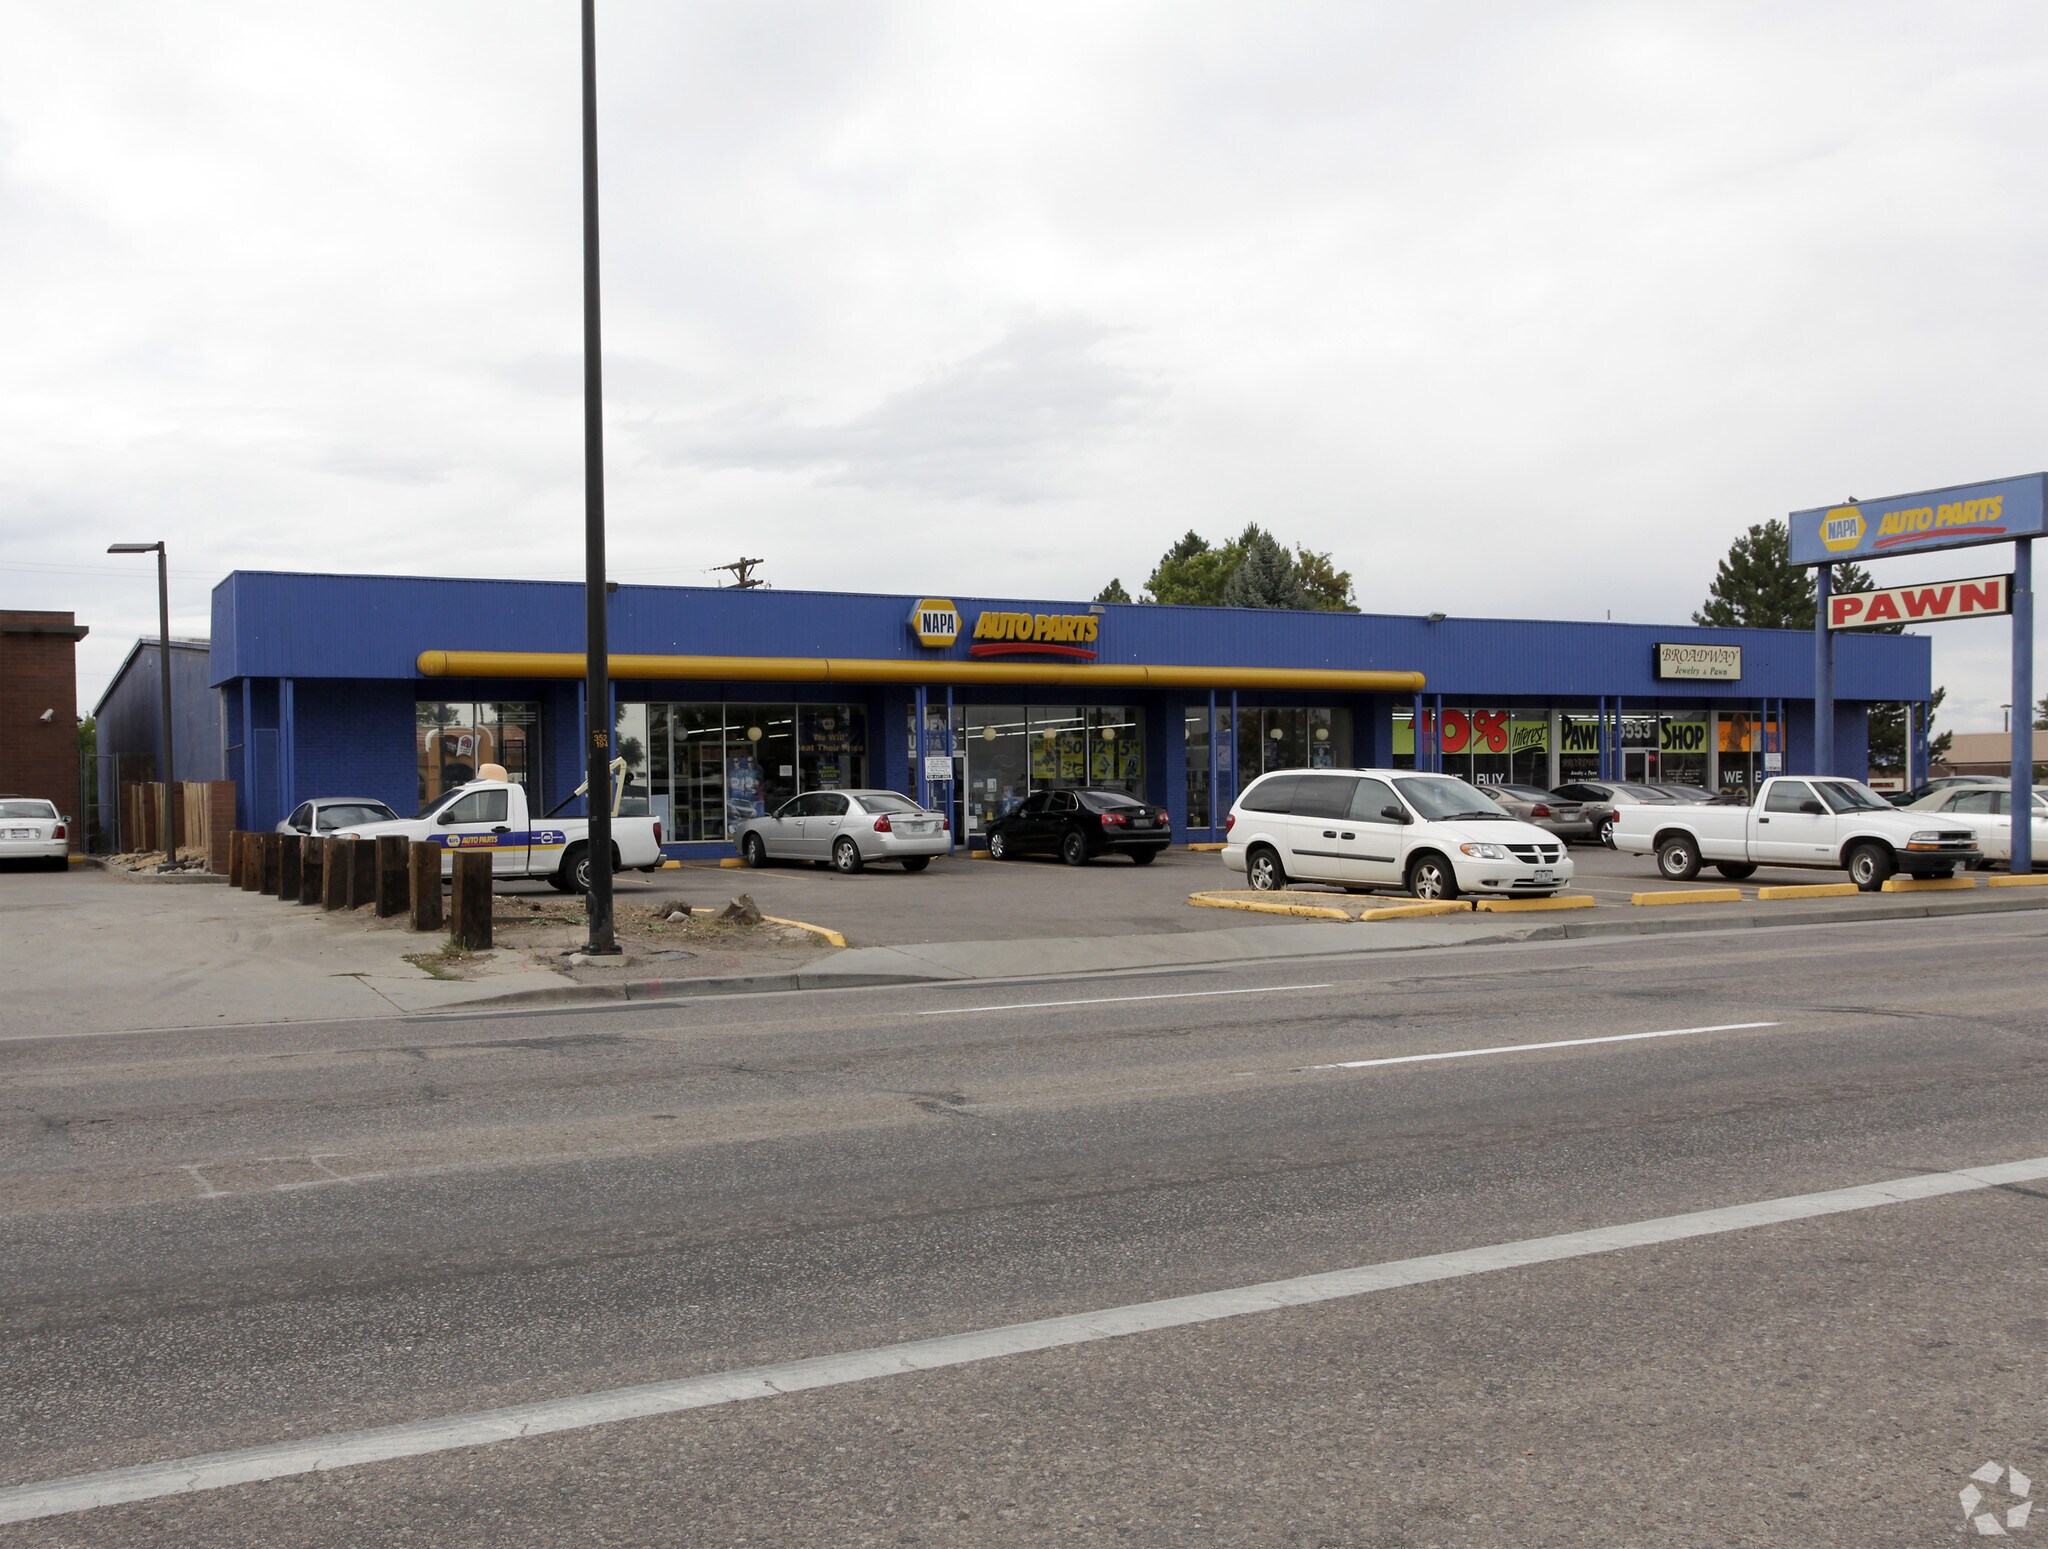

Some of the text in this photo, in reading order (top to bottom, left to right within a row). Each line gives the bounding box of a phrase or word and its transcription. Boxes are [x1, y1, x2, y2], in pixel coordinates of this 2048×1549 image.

[1877, 496, 2004, 536] AUTO PARTS
[1827, 519, 1858, 540] NAPA
[1832, 581, 2000, 625] PAWN
[922, 612, 955, 634] NAPA
[972, 611, 1100, 642] AUTO PARTS
[1662, 648, 1739, 667] BROADWAY
[1675, 666, 1700, 676] Jewelry
[1710, 667, 1728, 676] Pawn
[1661, 717, 1705, 750] SHOP
[1476, 773, 1505, 785] BUY
[1723, 771, 1744, 783] WE
